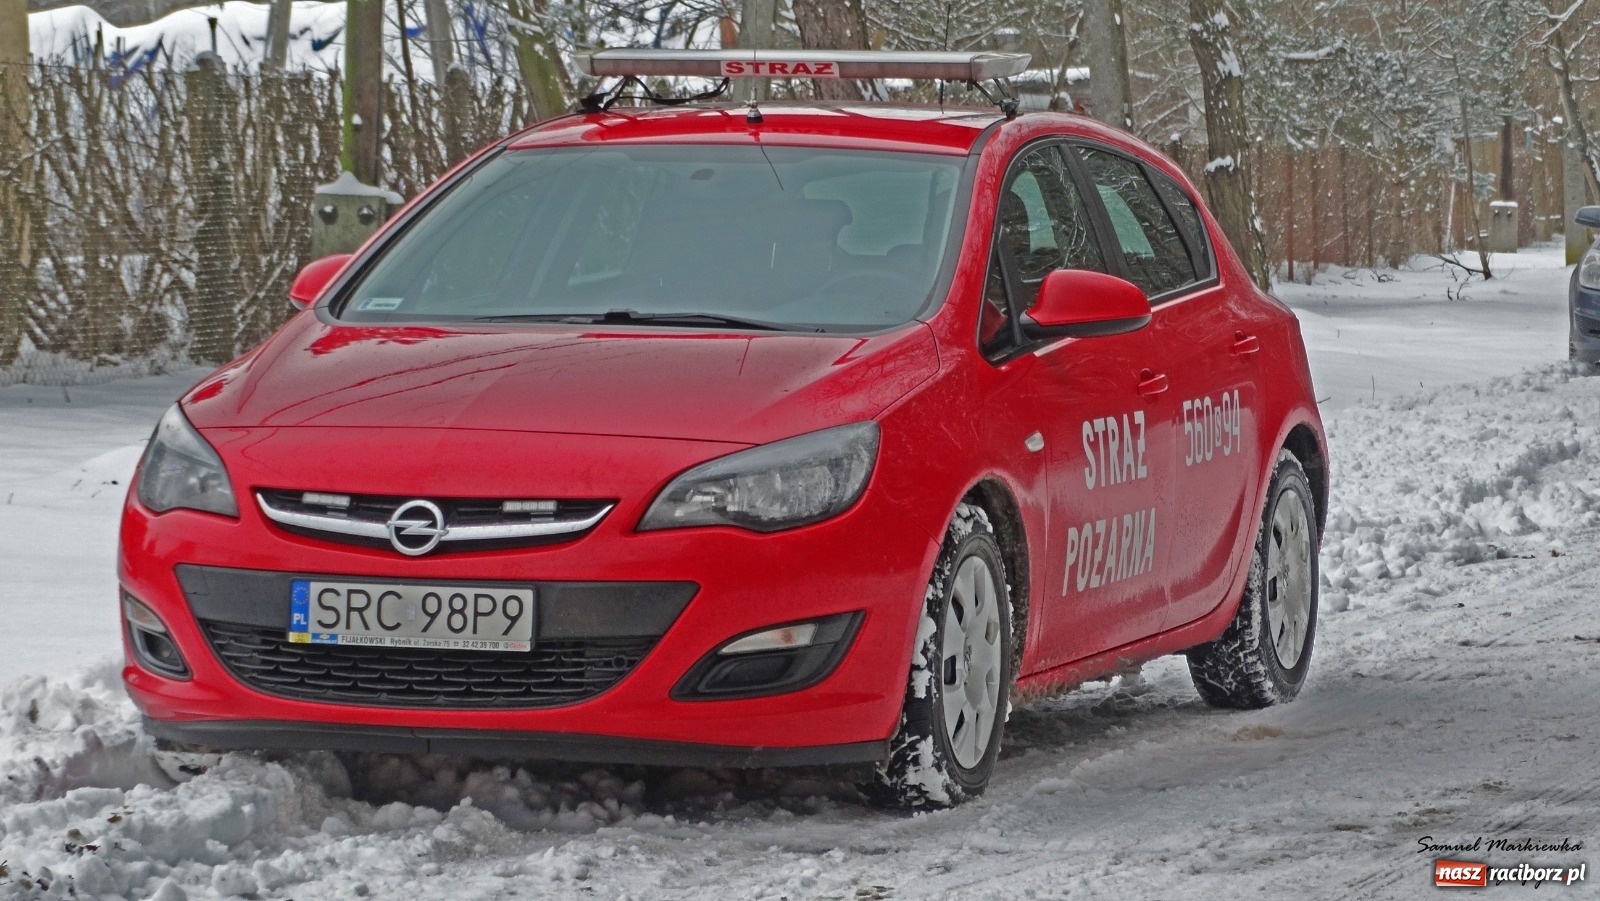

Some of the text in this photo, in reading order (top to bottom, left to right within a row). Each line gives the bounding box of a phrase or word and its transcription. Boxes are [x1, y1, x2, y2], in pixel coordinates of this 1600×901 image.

[316, 587, 524, 636] SRC 98P9
[293, 613, 307, 625] PL
[462, 640, 469, 648] 32
[471, 641, 479, 649] 42
